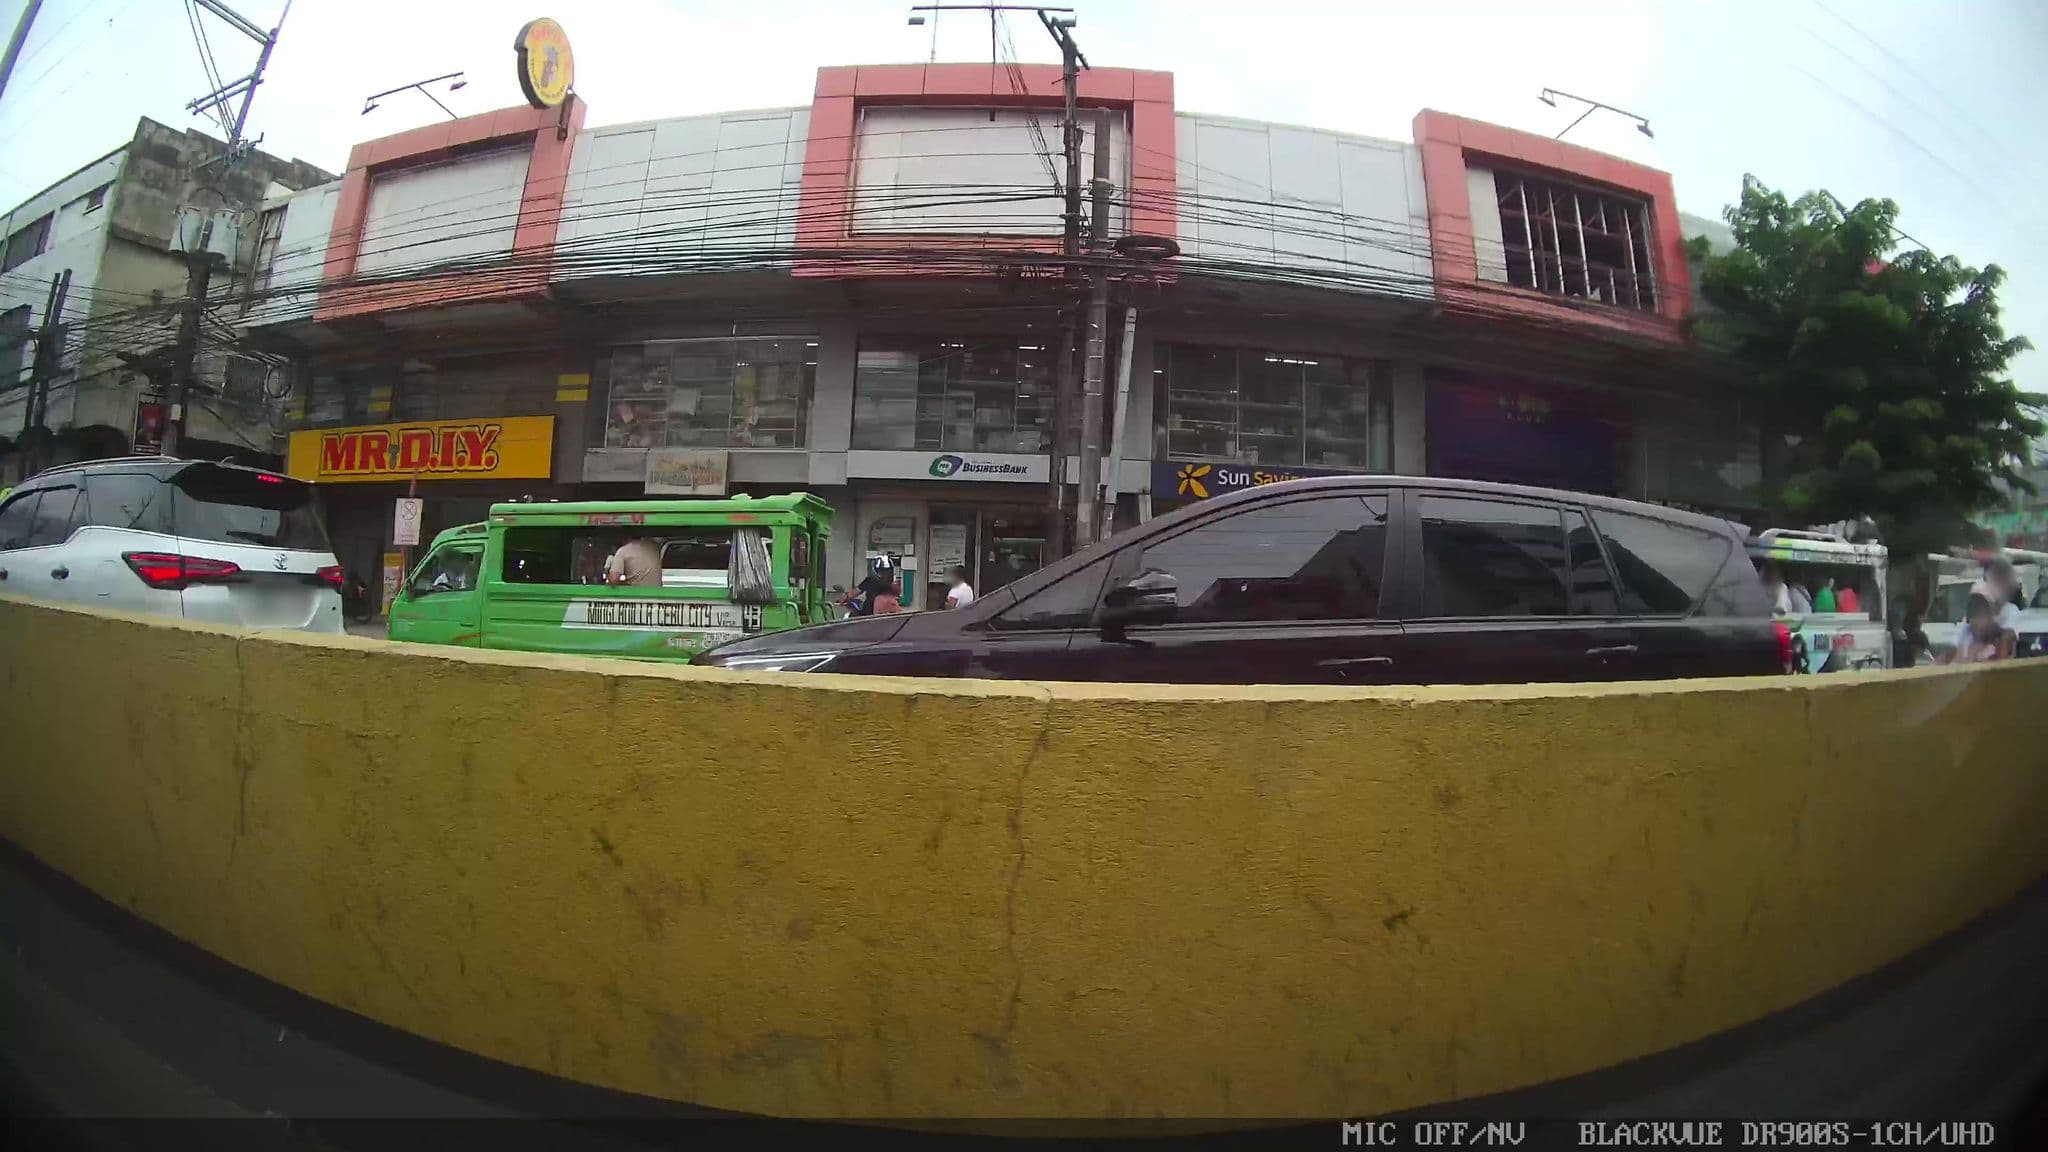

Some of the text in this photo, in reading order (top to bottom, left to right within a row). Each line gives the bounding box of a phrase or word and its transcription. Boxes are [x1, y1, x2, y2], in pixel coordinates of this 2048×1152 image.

[321, 432, 388, 472] MR
[1218, 469, 1250, 485] Sun
[688, 603, 712, 627] CITY
